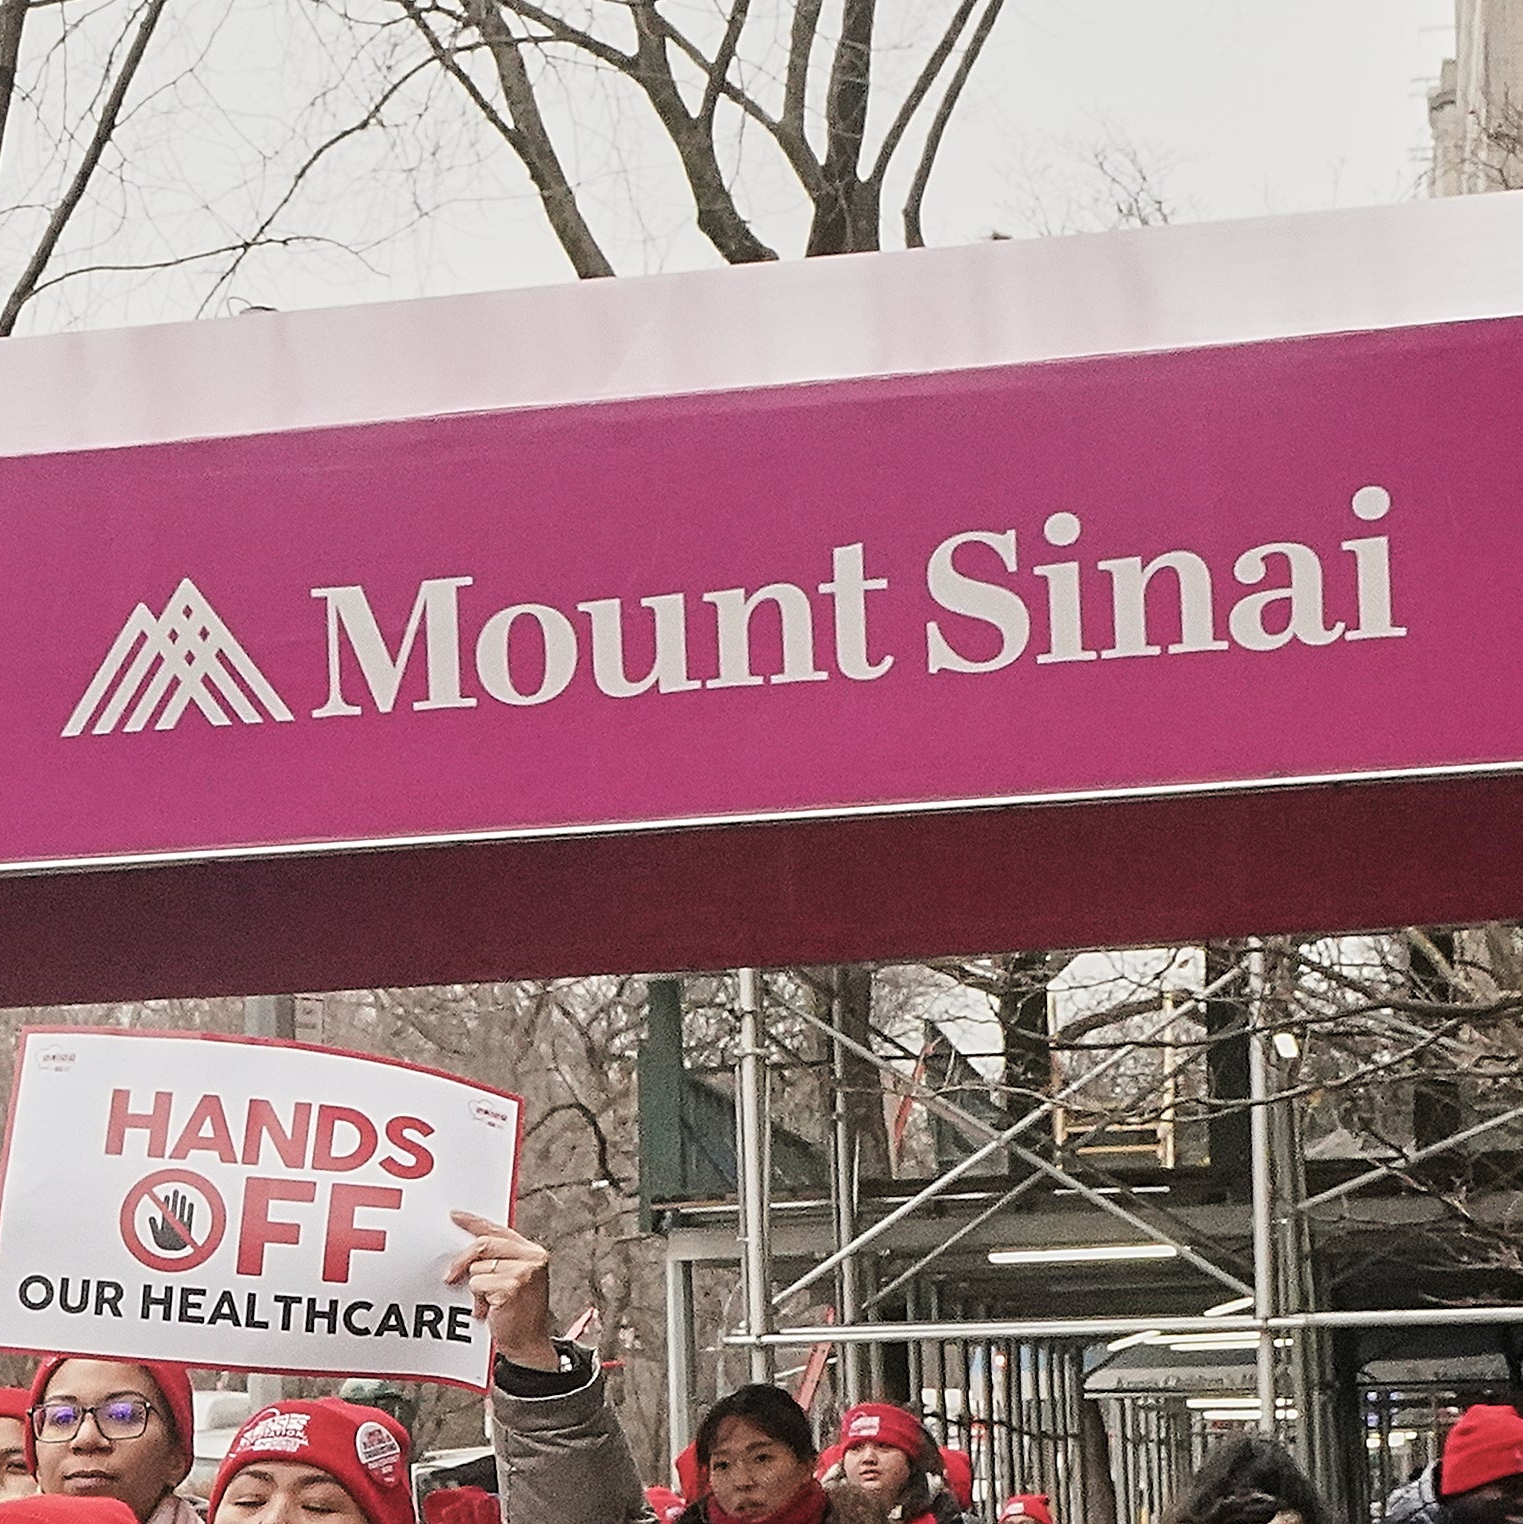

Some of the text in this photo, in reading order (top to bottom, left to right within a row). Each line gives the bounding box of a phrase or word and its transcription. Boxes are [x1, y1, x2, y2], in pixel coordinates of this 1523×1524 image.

[309, 485, 1408, 720] Mount Sinai
[104, 1088, 436, 1180] HANDS
[18, 1274, 474, 1345] OUR HEALTHCARE
